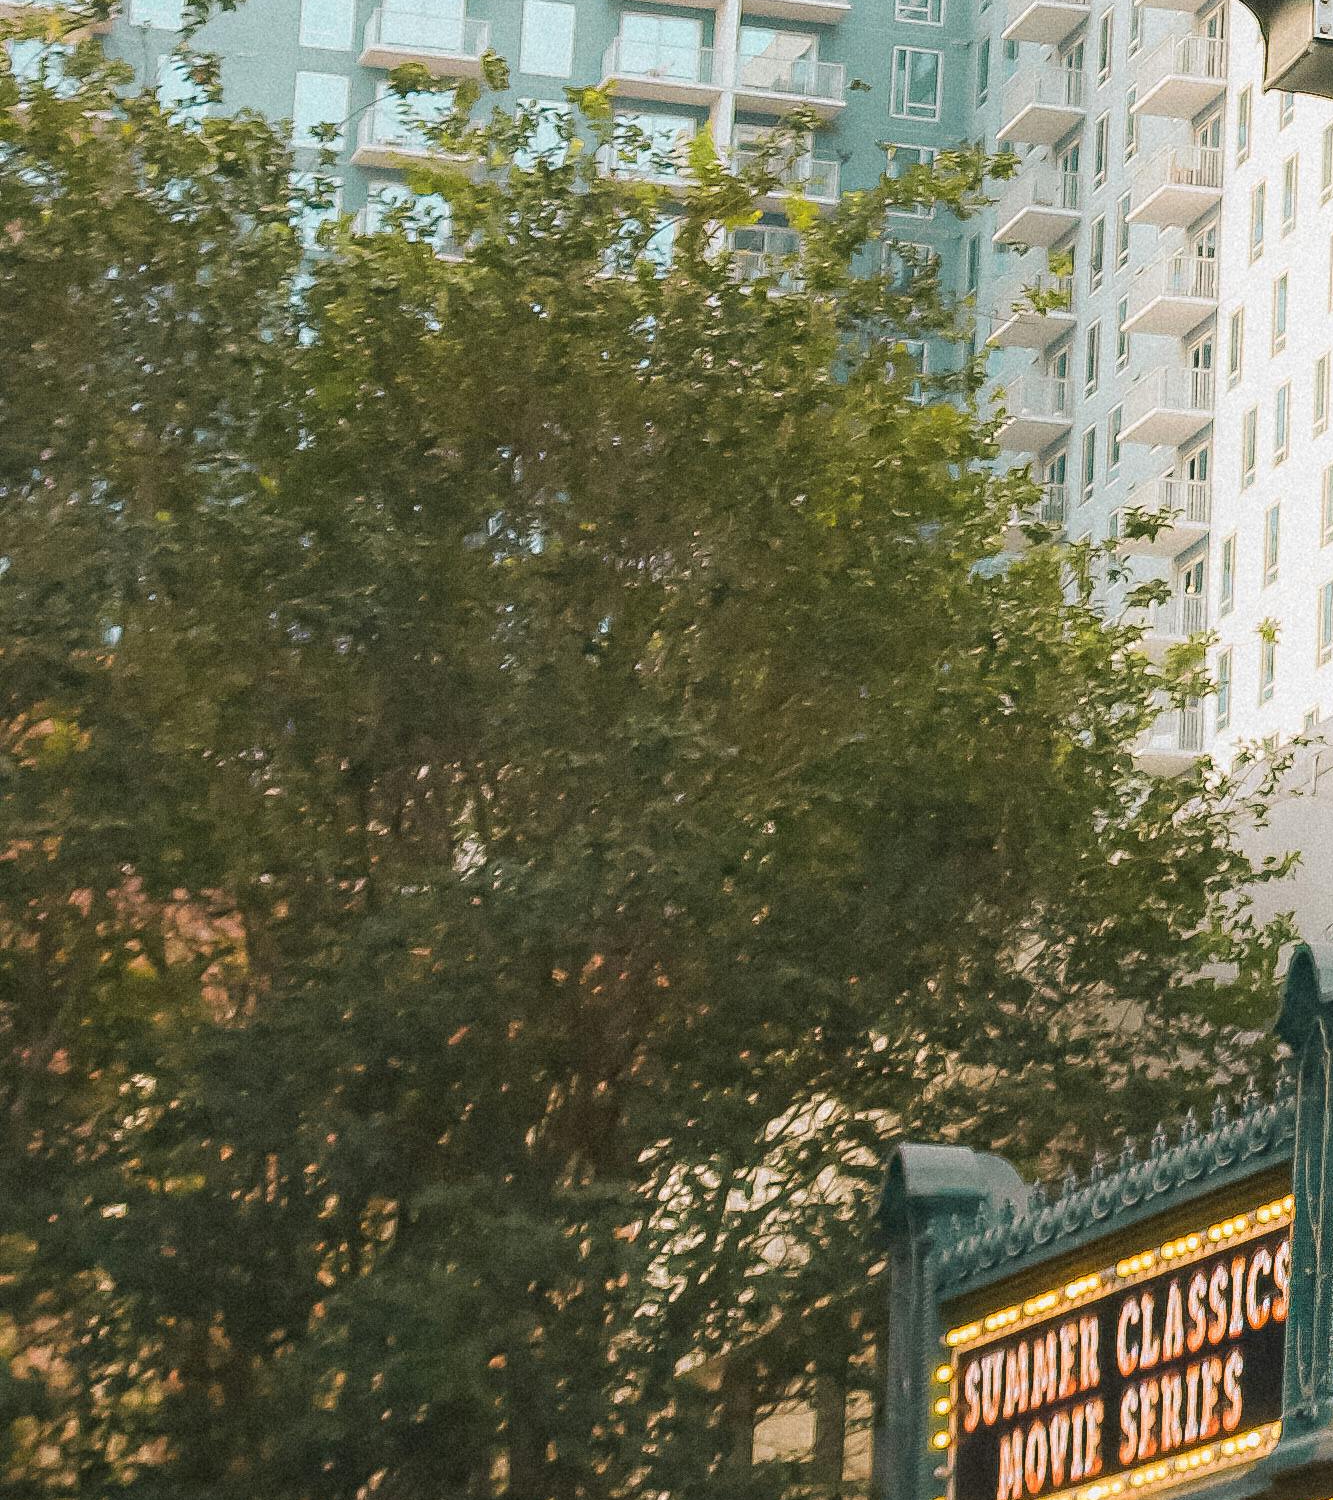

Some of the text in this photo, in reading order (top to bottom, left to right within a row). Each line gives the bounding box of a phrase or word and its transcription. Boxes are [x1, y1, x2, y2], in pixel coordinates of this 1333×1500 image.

[963, 1238, 1292, 1434] SUMMER CLASSICS
[1118, 1347, 1244, 1466] SERIES
